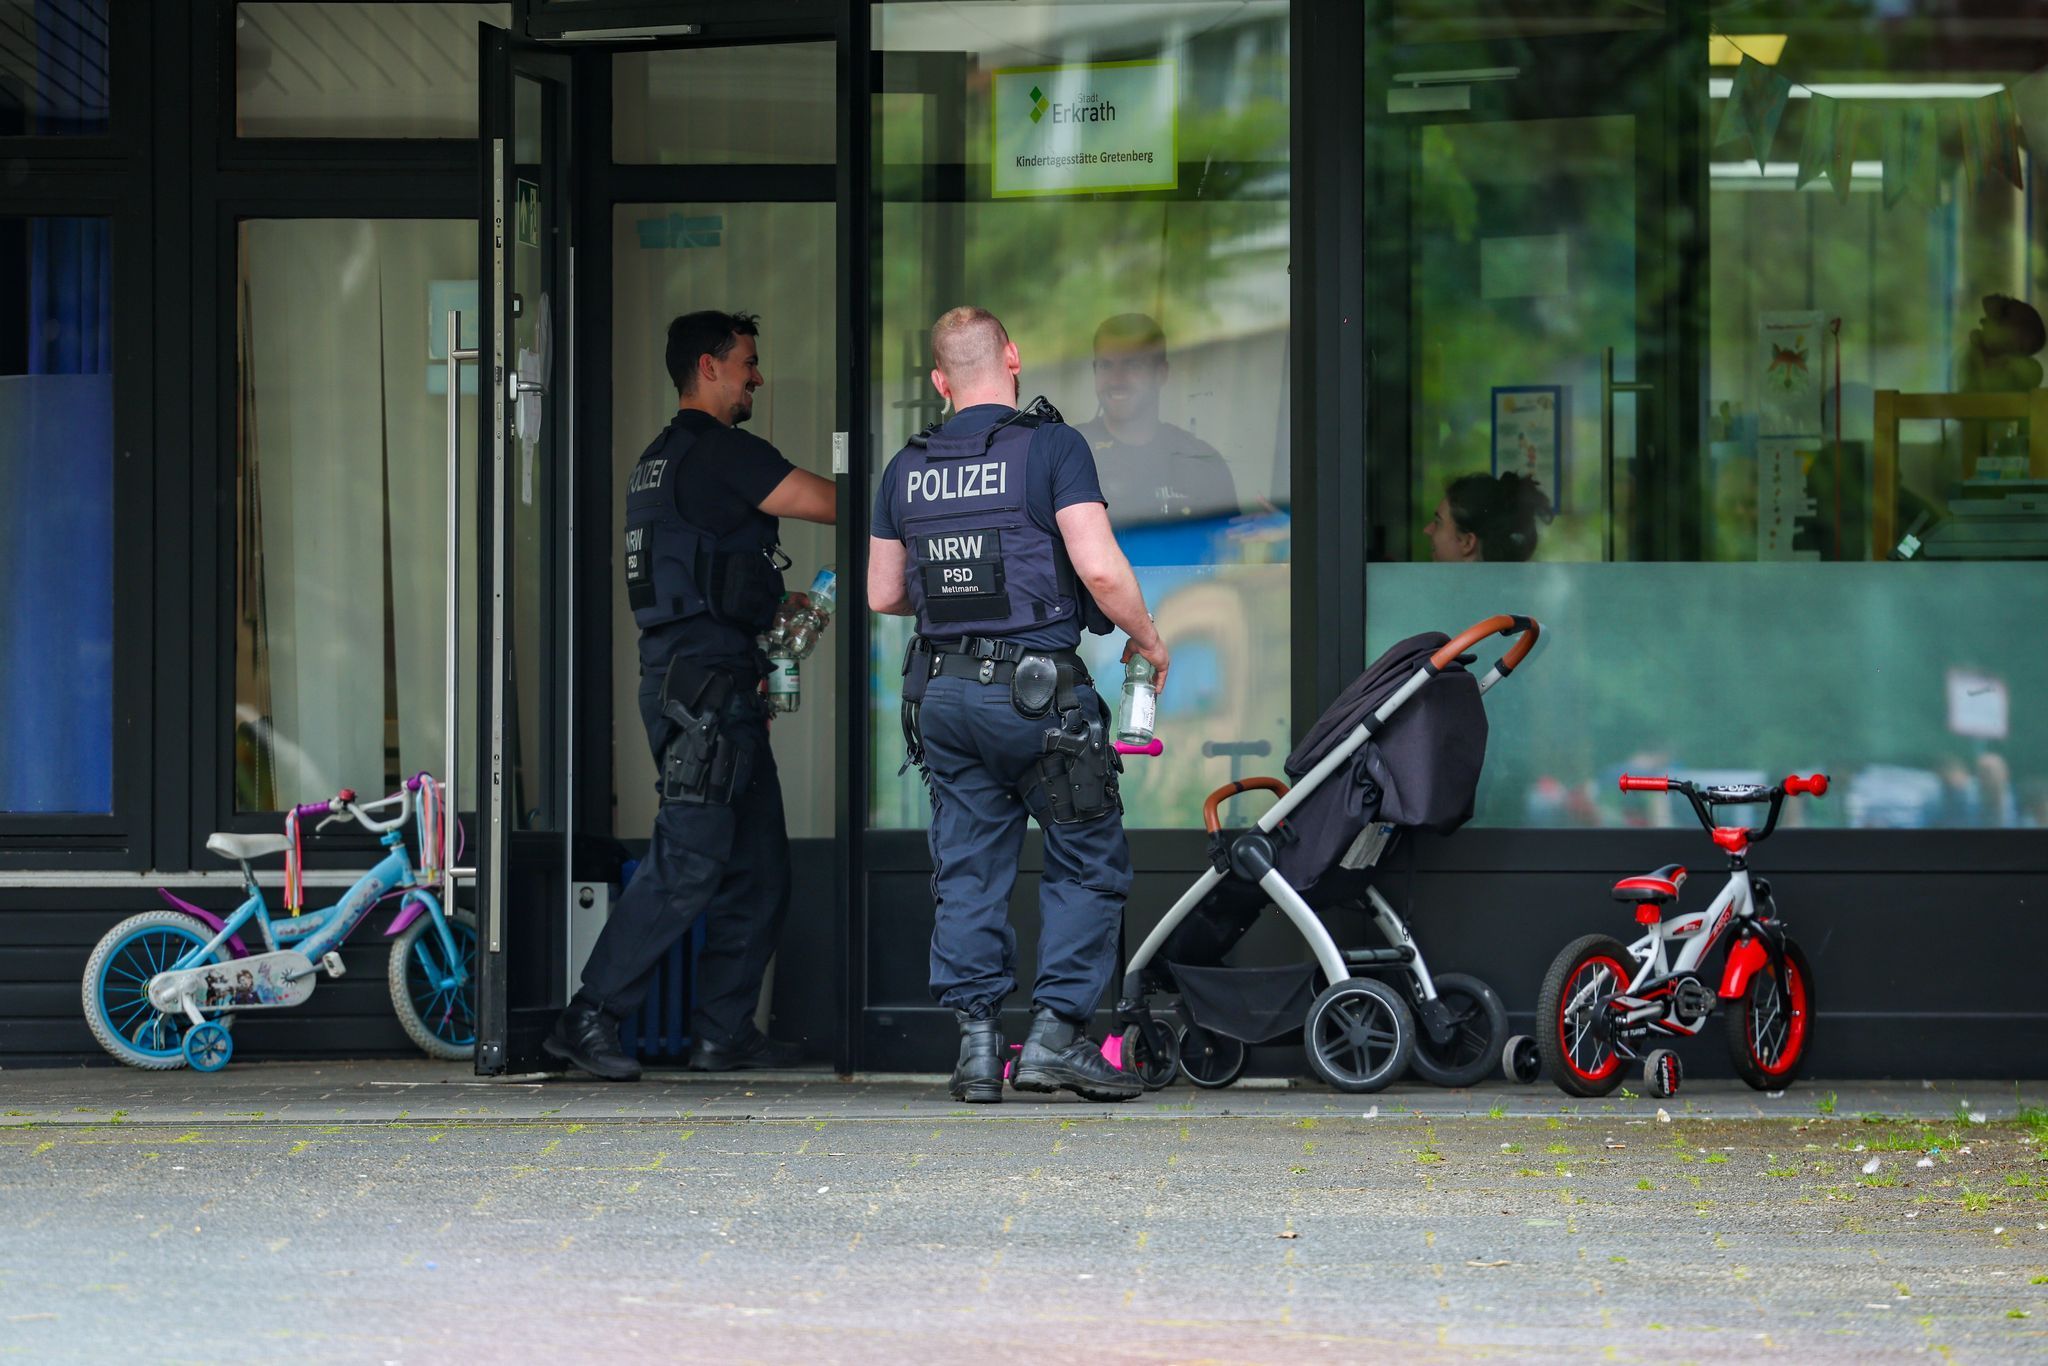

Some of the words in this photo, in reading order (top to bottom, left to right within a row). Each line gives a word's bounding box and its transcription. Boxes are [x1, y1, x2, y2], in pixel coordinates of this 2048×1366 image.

[1078, 93, 1099, 103] Stadt
[1053, 101, 1115, 124] Erkrath
[1016, 153, 1098, 167] Kindertagesstätte
[1100, 150, 1154, 165] Gretenberg
[907, 461, 1007, 503] POLIZEI
[928, 535, 983, 562] NRW
[943, 567, 974, 583] PSD
[941, 584, 979, 594] Mettmann
[1661, 1055, 1670, 1095] TURBO
